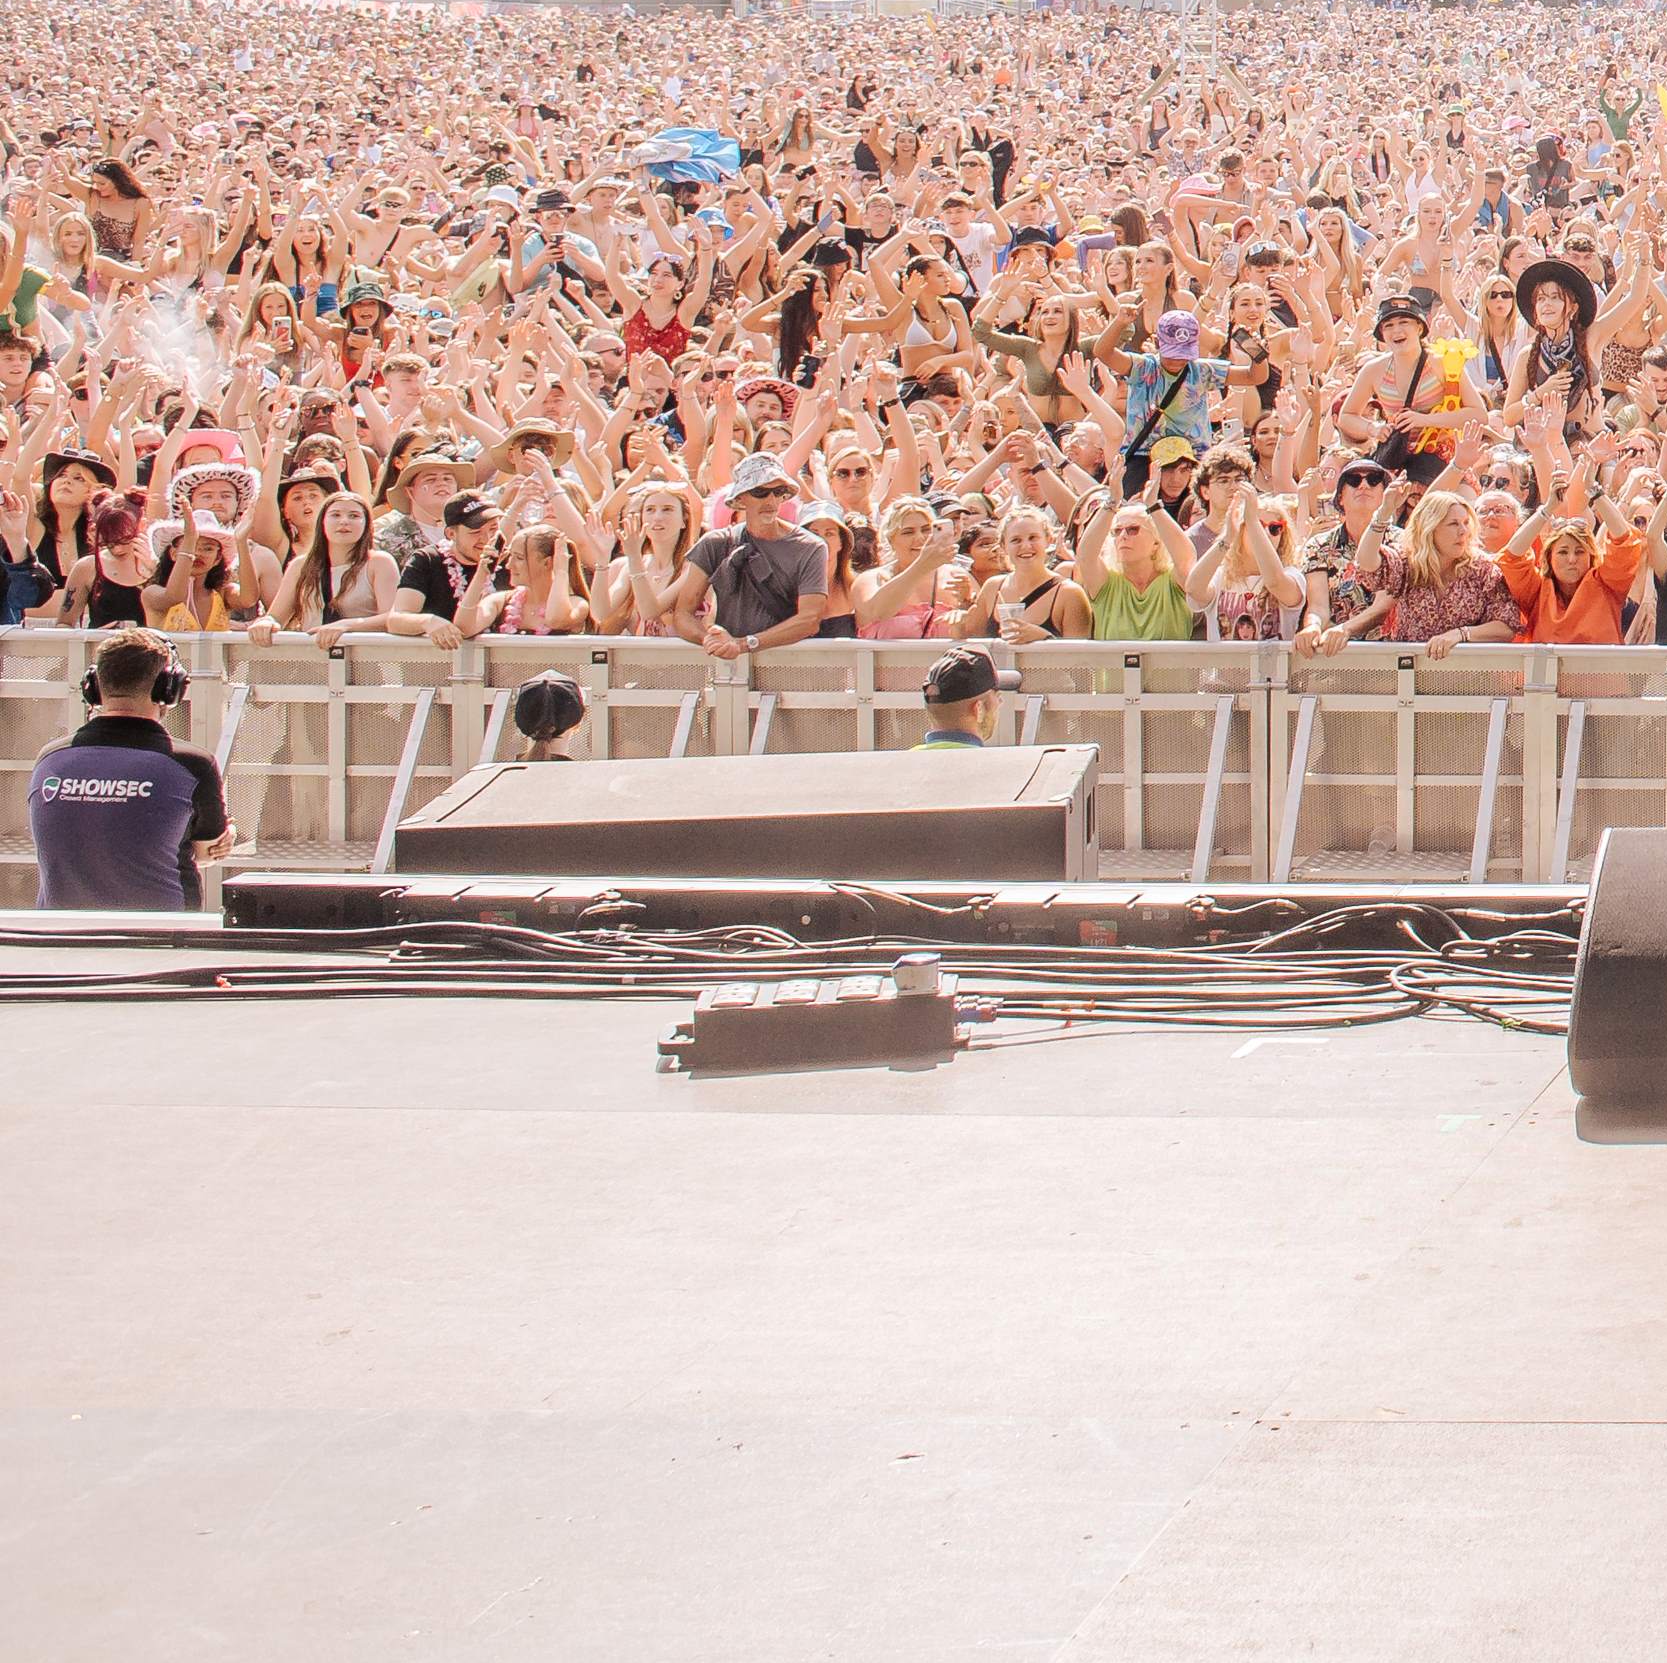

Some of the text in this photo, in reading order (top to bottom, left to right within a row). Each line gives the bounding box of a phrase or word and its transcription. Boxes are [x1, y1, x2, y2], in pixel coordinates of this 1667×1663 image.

[61, 778, 153, 797] SHOWSEC
[60, 794, 127, 803] Crowd Management
